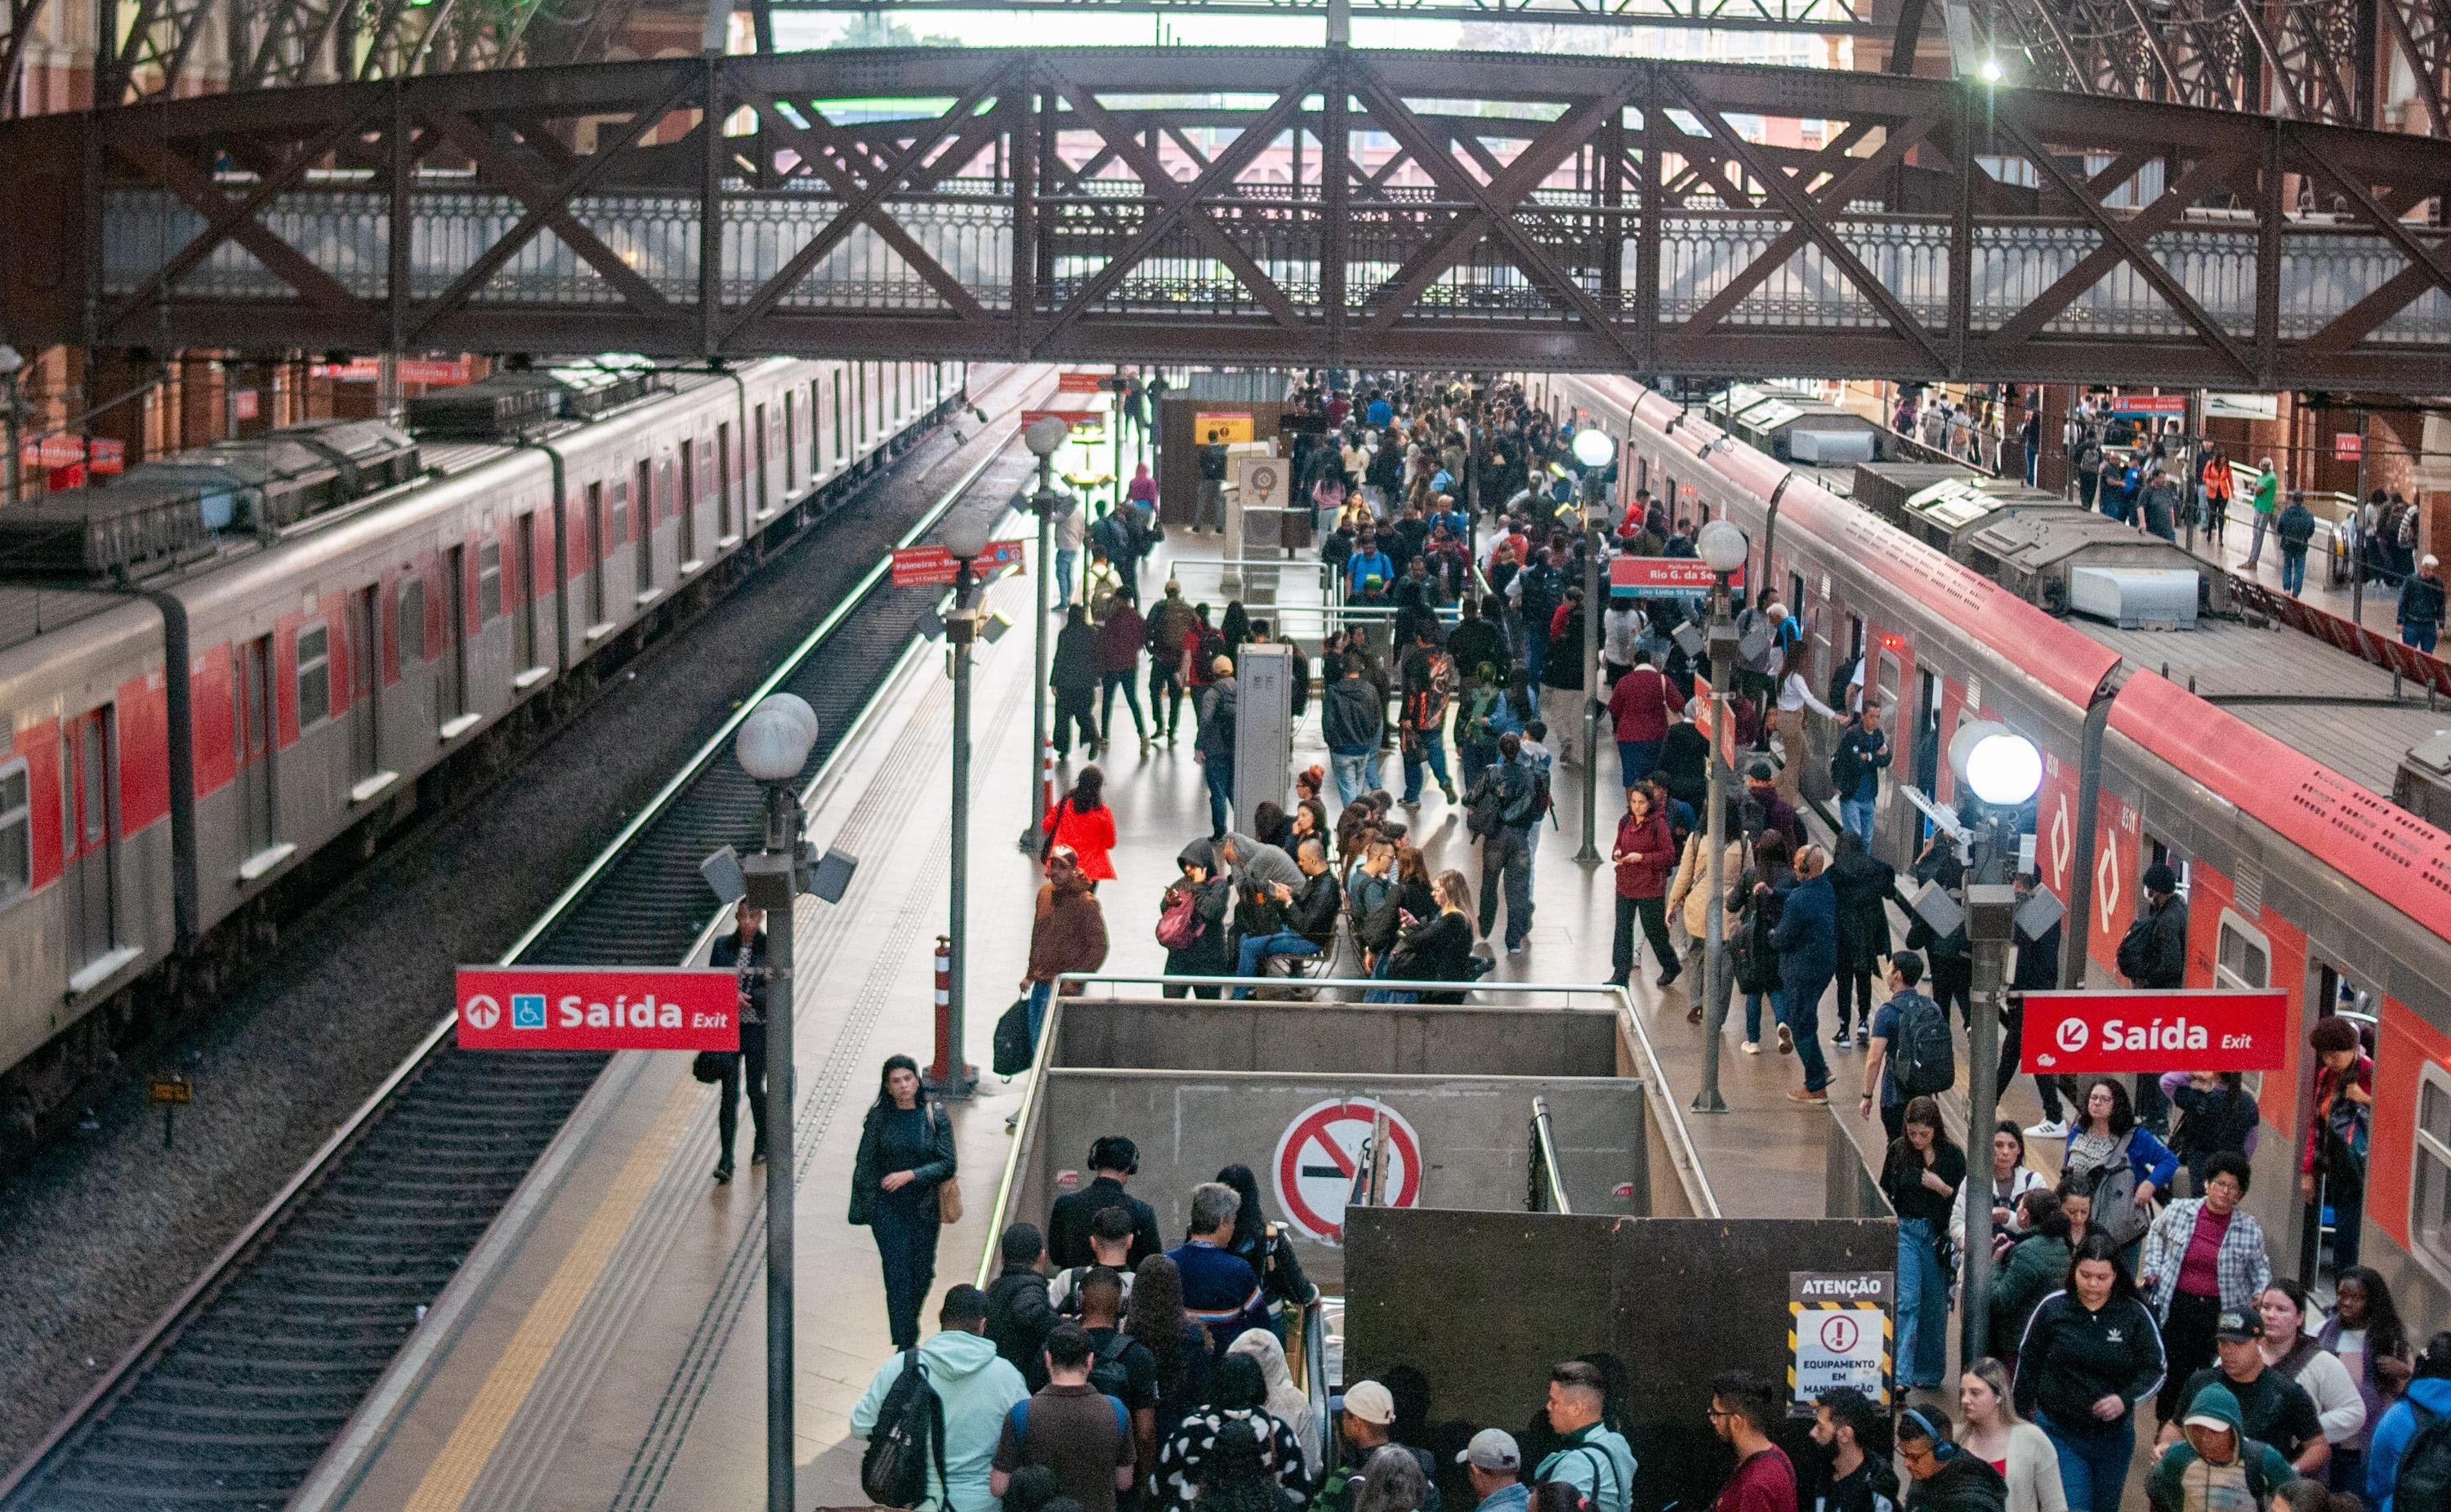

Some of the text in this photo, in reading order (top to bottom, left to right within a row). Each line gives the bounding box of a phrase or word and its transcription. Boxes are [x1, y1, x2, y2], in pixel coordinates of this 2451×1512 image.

[896, 560, 937, 570] Palmeiras
[1650, 570, 1667, 579] Rio
[1671, 570, 1681, 580] G.
[1684, 570, 1697, 580] da
[2121, 805, 2136, 834] 8511
[559, 994, 729, 1028] Saída Exit
[2102, 1017, 2252, 1050] Saída Exit
[1801, 1277, 1882, 1298] ATENÇÃO
[1804, 1360, 1875, 1369] EQUIPAMENTO
[1832, 1373, 1846, 1381] EM
